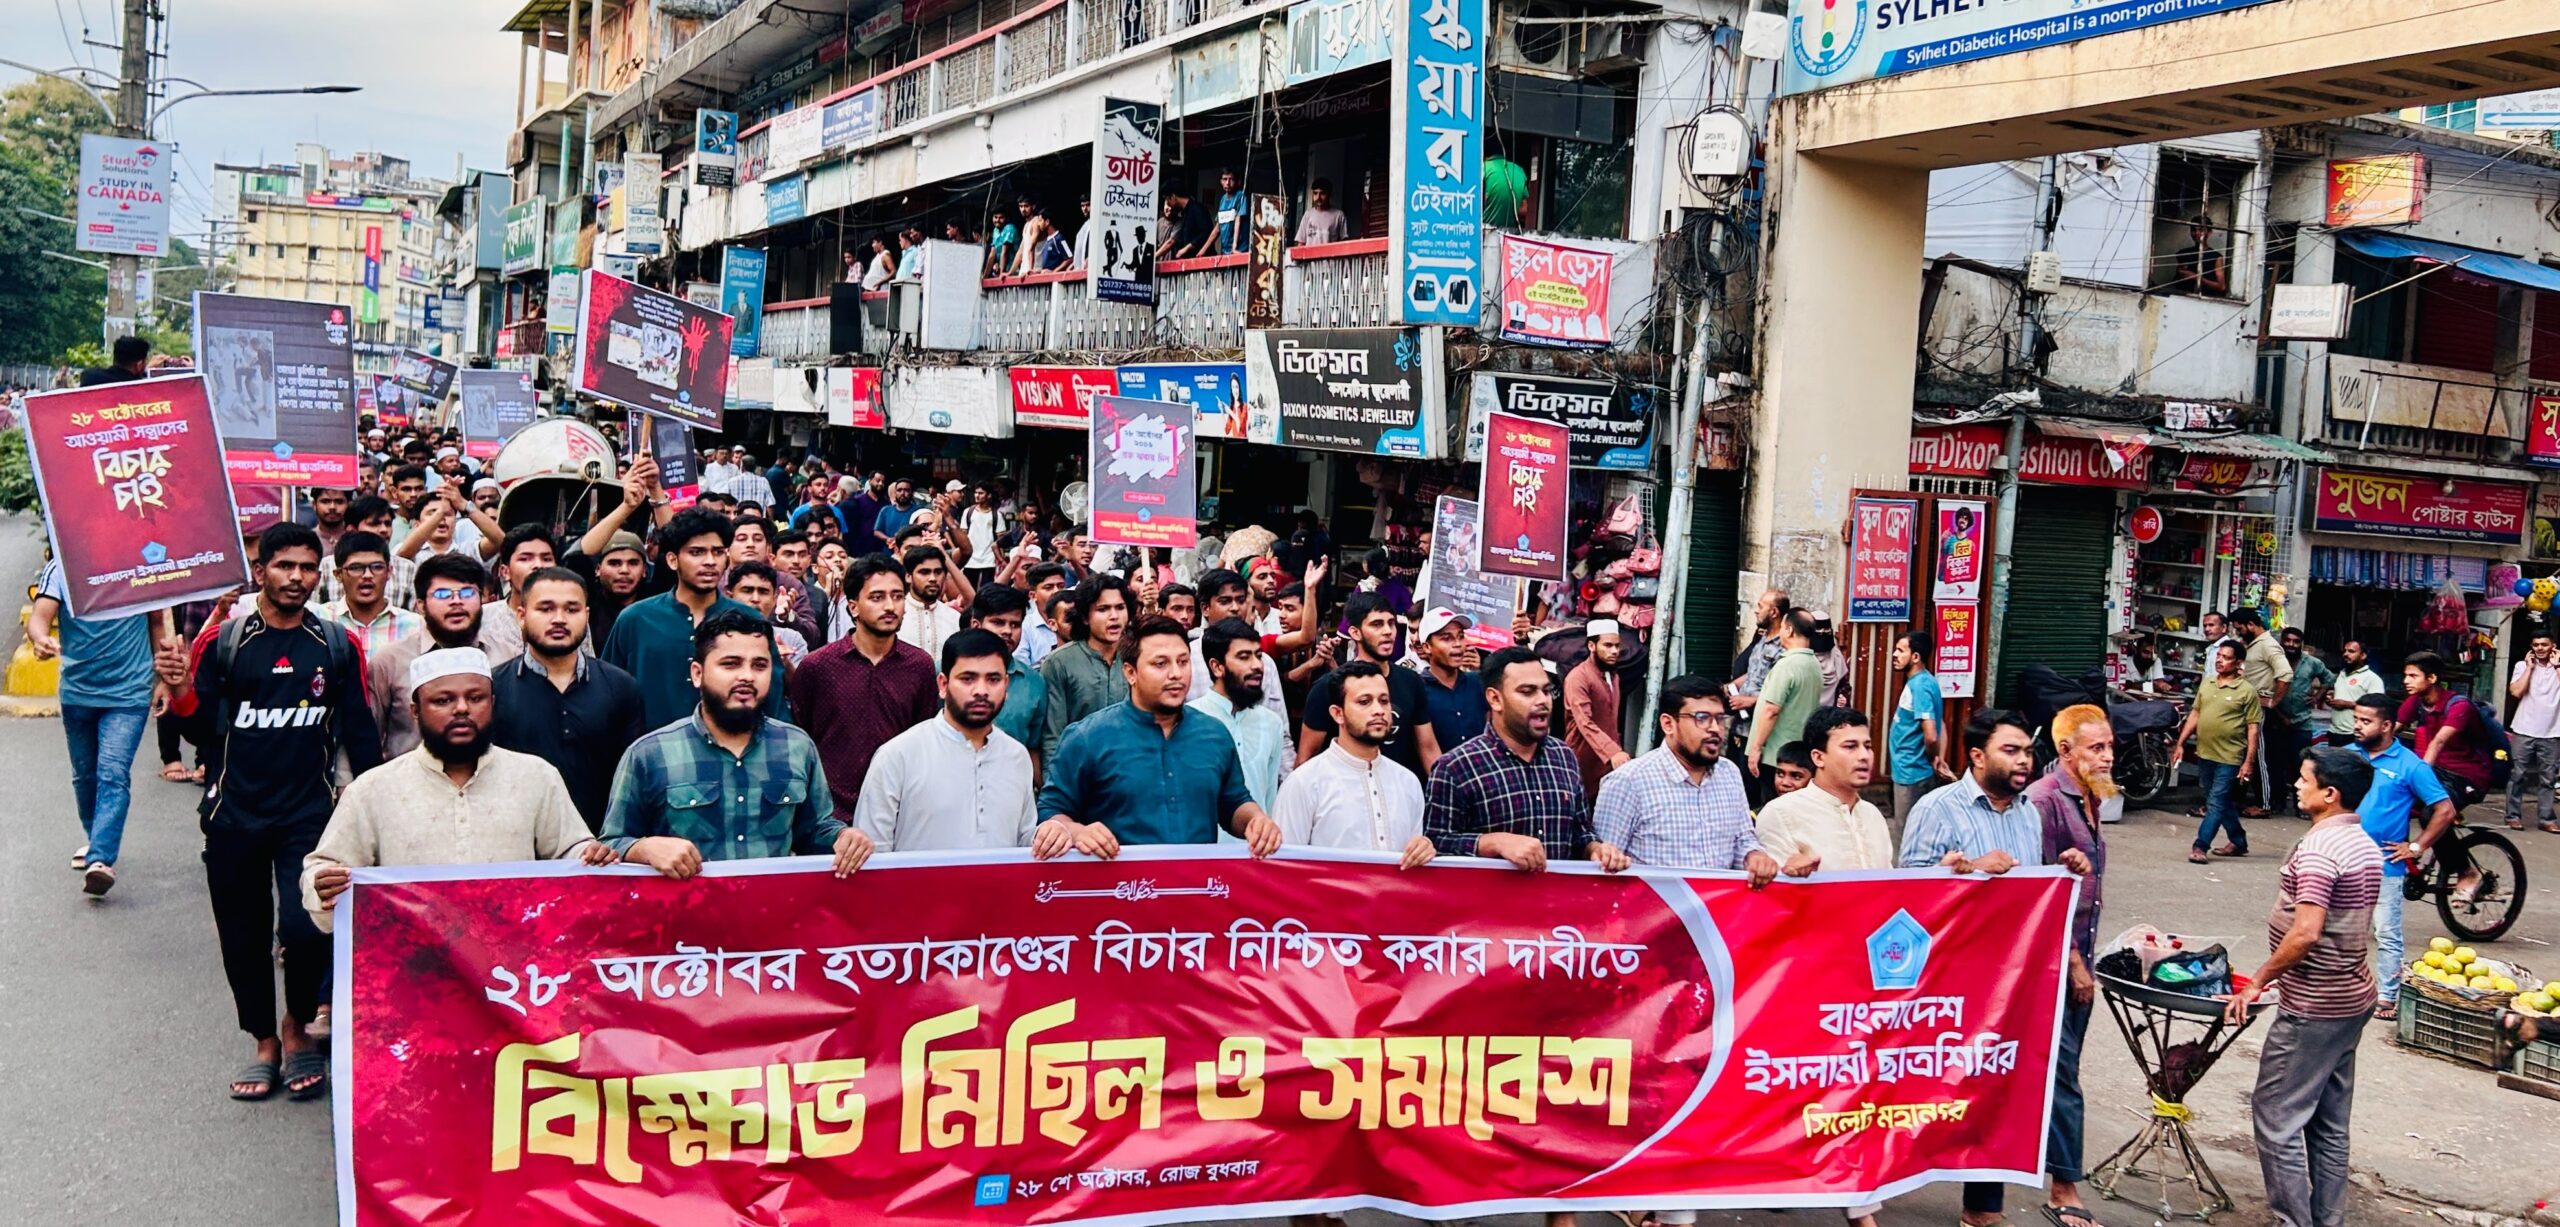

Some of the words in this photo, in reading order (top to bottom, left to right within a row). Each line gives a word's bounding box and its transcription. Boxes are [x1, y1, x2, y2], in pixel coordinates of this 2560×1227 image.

[1876, 0, 1985, 29] SYLHE
[1906, 43, 1947, 64] Sylhet
[1949, 31, 2005, 56] Diabetic
[2009, 16, 2070, 44] Hospital
[2073, 16, 2084, 30] is
[2087, 16, 2097, 27] a
[2100, 0, 2183, 26] non-profit
[102, 154, 137, 167] Study
[102, 164, 149, 175] Solutions
[1104, 148, 1157, 187] আর্ট
[87, 185, 163, 203] CANADA
[99, 177, 137, 189] STUDY
[141, 181, 153, 190] IN
[1104, 185, 1153, 212] টেইলার্স
[1410, 181, 1477, 217] টেইলার্স
[1507, 240, 1554, 282] স্কুল
[1557, 250, 1608, 288] ড্রেস
[1016, 369, 1064, 408] VISION
[71, 411, 95, 427] ২৮
[98, 400, 172, 422] অক্টোবরের
[1282, 402, 1308, 418] DIXON
[1309, 403, 1359, 423] COSMETICS
[1360, 408, 1415, 426] JEWELLERY
[64, 424, 130, 449] আওয়ামী
[133, 419, 188, 441] সন্ত্রাসের
[1505, 430, 1518, 443] ২৮
[1518, 433, 1552, 449] অক্টোবরের
[1591, 435, 1638, 446] JEWELLERY
[92, 443, 177, 487] বিচার
[1939, 431, 2000, 471] Dixon
[1508, 460, 1549, 492] বিচার
[112, 472, 168, 518] চাই
[1512, 486, 1537, 518] চাই
[2327, 472, 2413, 518] সুজন
[1858, 505, 1882, 546] স্কুল
[1886, 505, 1911, 542] ড্রেস
[2142, 517, 2157, 530] রবি
[2412, 502, 2469, 526] পোষ্টার
[2473, 507, 2516, 530] হাউস
[87, 569, 136, 586] বাংলাদেশ
[136, 559, 176, 578] ইসলামী
[178, 550, 225, 570] ছাত্রশিবির
[1856, 547, 1872, 564] এই
[1873, 547, 1907, 564] মার্কেটের
[1862, 568, 1876, 581] ২য়
[1877, 567, 1901, 581] তলায়
[1856, 584, 1881, 597] পাওয়া
[1884, 584, 1898, 597] যায়
[234, 699, 327, 729] bwin
[484, 963, 572, 1017] ২৮
[592, 940, 806, 1002] অক্টোবর
[817, 930, 1077, 994] হত্যাকাণ্ডের
[1091, 918, 1214, 976] বিচার
[1224, 916, 1370, 973] নিশ্চিত
[1379, 930, 1493, 976] করার
[1502, 926, 1649, 981] দাবীতে
[1818, 994, 1965, 1036] বাংলাদেশ
[1744, 1039, 1871, 1094] ইসলামী
[1876, 1031, 2019, 1085] ছাত্রশিবির
[491, 1032, 866, 1184] বিক্ষোভ
[899, 997, 1165, 1156] মিছিল
[1194, 1036, 1266, 1121] ও
[1299, 1035, 1632, 1141] সমাবেশ
[1801, 1101, 1877, 1139] সিলেট
[1877, 1099, 1969, 1132] মহানগর
[1014, 1176, 1044, 1197] ২৮
[1049, 1171, 1073, 1193] শে
[1077, 1164, 1151, 1192] অক্টোবর,
[1159, 1161, 1200, 1184] রোজ
[1206, 1157, 1261, 1183] বুধবার
